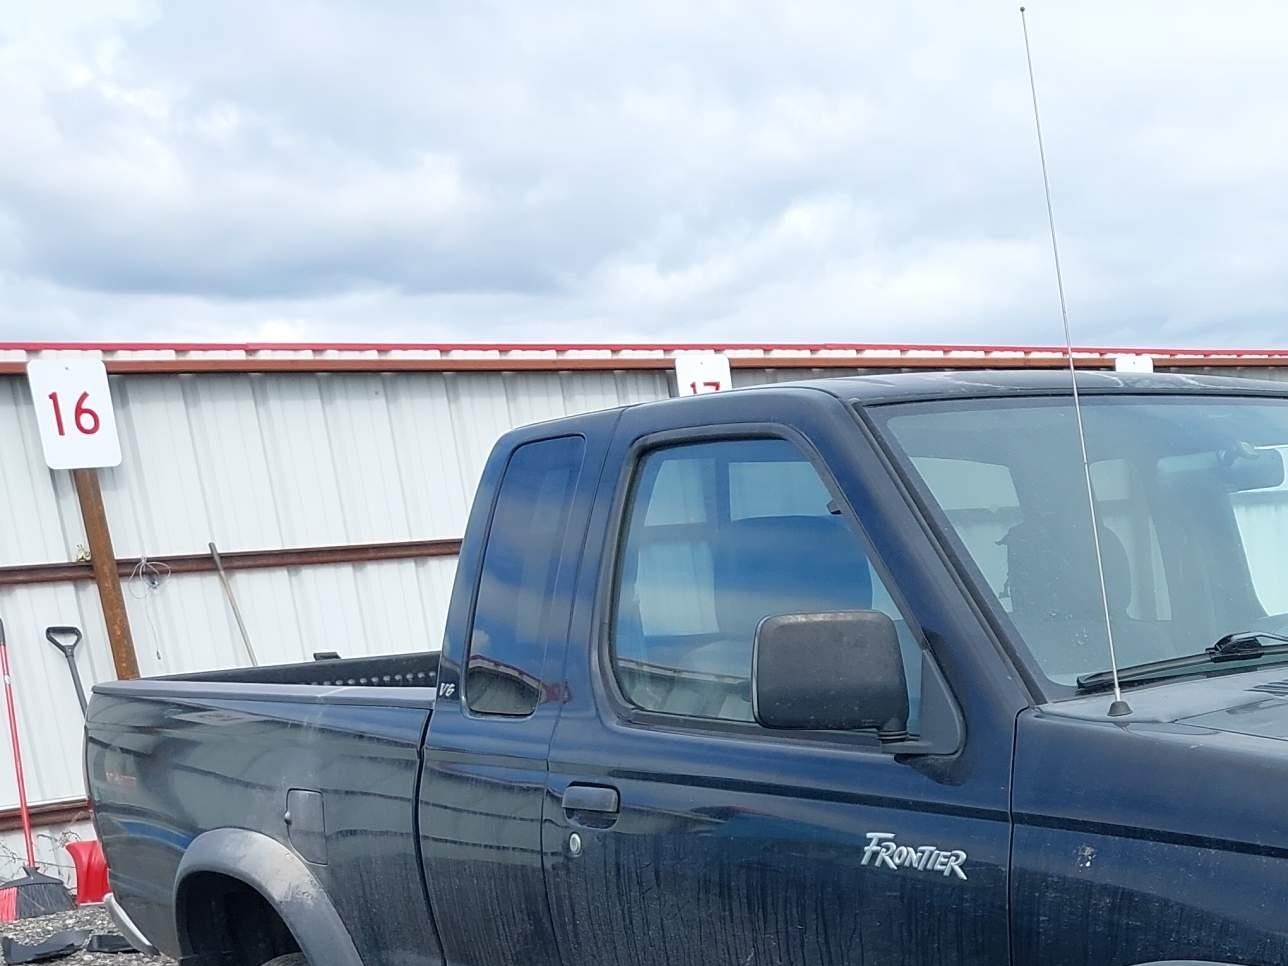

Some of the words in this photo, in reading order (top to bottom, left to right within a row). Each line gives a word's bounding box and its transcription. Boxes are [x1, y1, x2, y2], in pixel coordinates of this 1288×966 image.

[48, 391, 100, 436] 16
[439, 682, 456, 697] V6
[860, 832, 968, 881] FRONTIER
